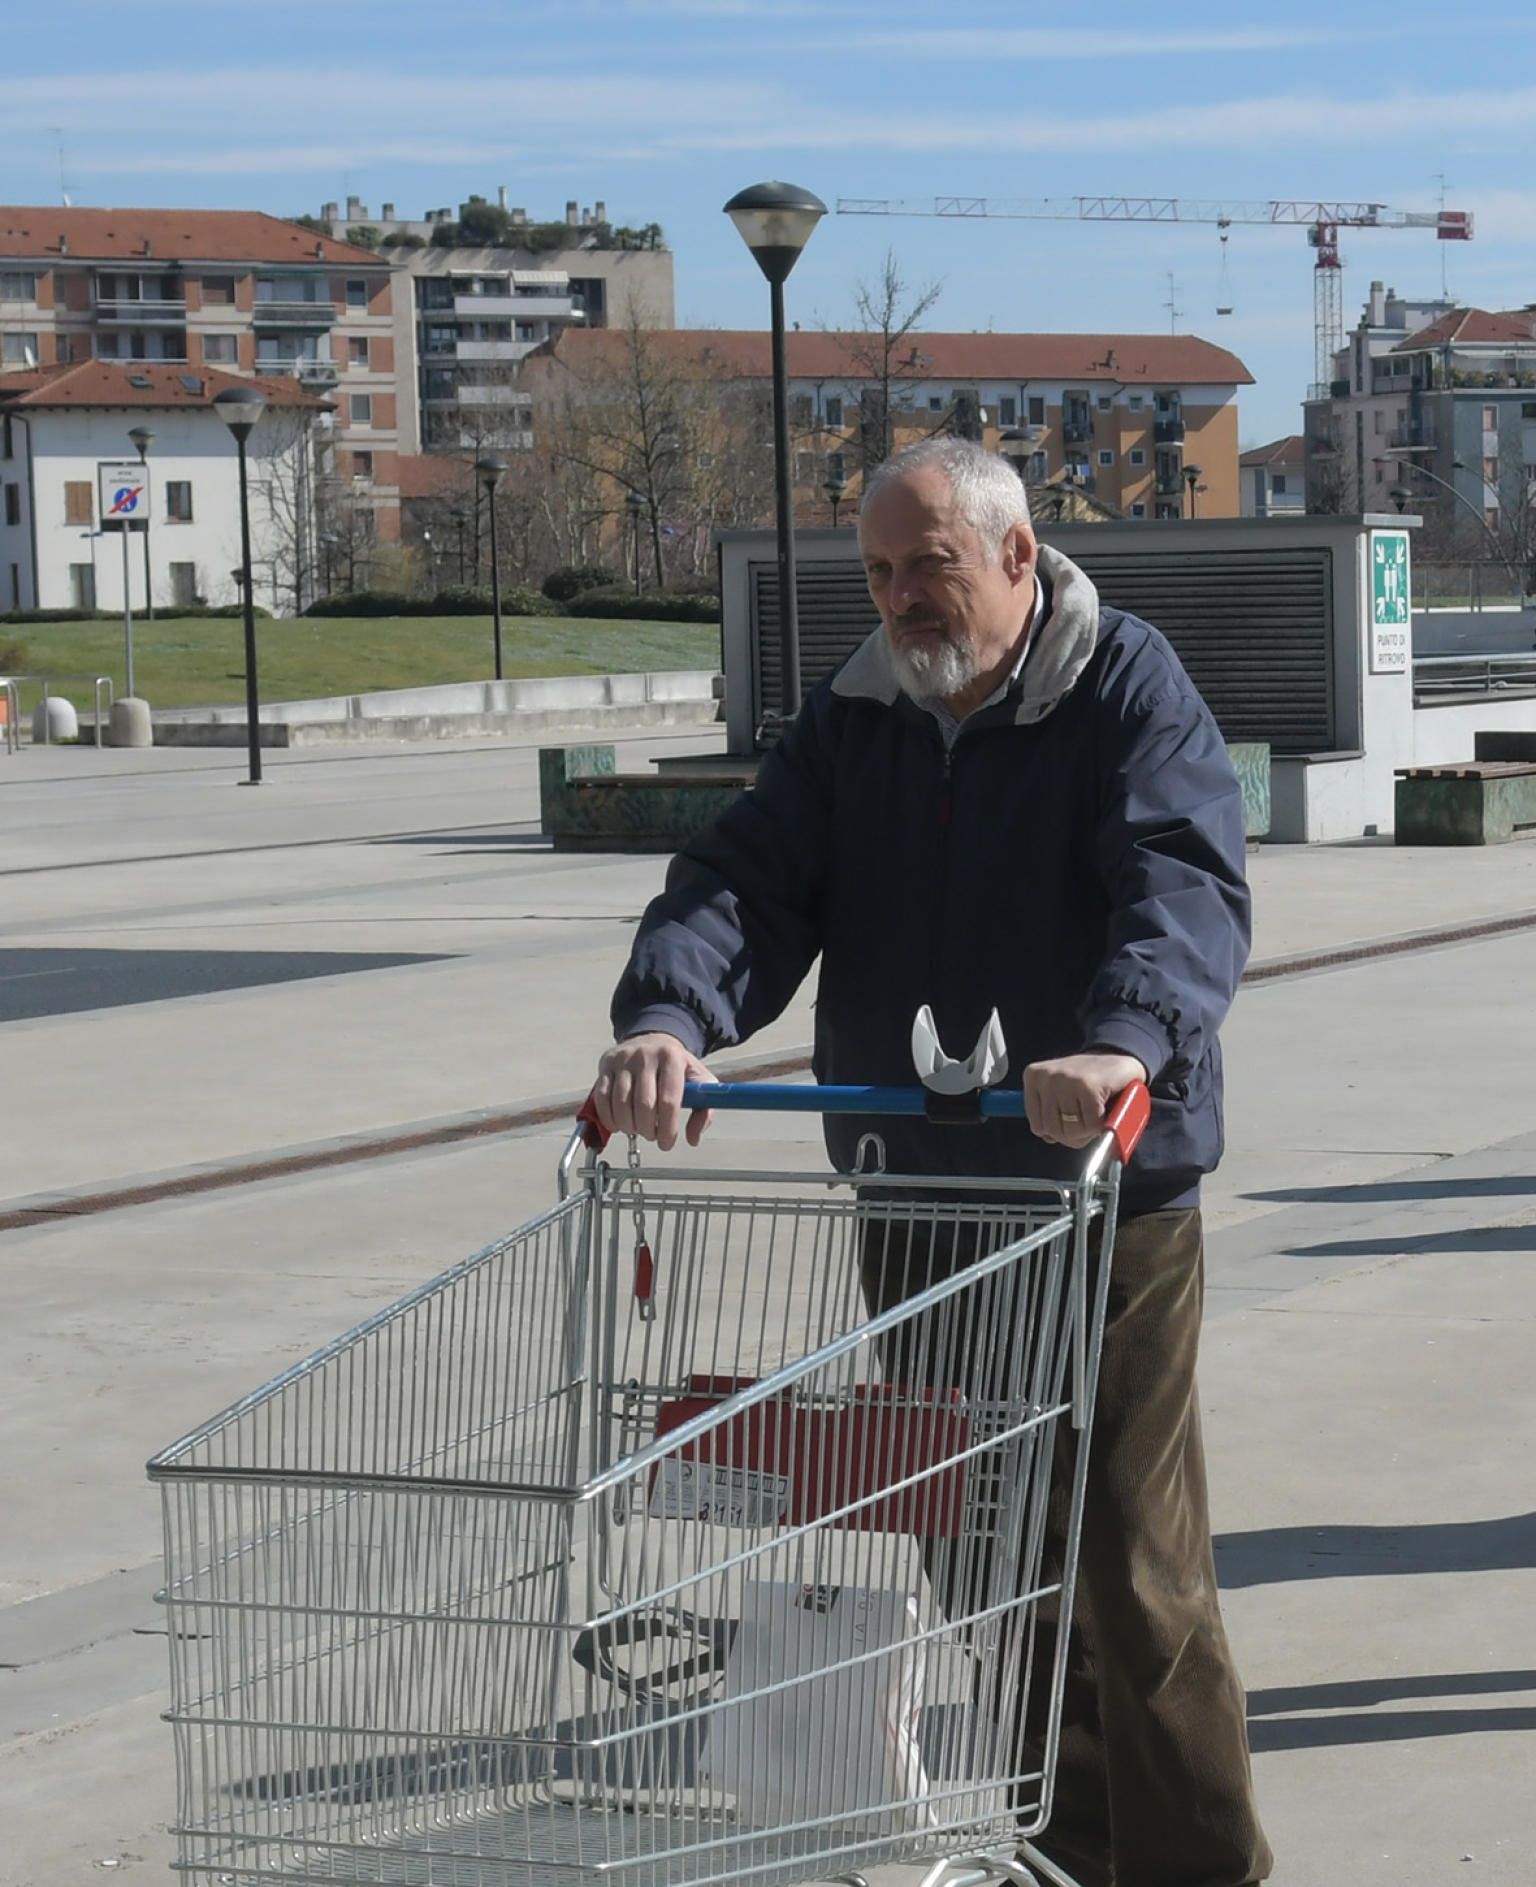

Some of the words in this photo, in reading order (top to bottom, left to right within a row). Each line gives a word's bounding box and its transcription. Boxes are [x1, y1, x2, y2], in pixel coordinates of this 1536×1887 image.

[1377, 634, 1398, 646] PUNTO
[1399, 634, 1406, 646] DI
[1377, 652, 1406, 664] RITROVO
